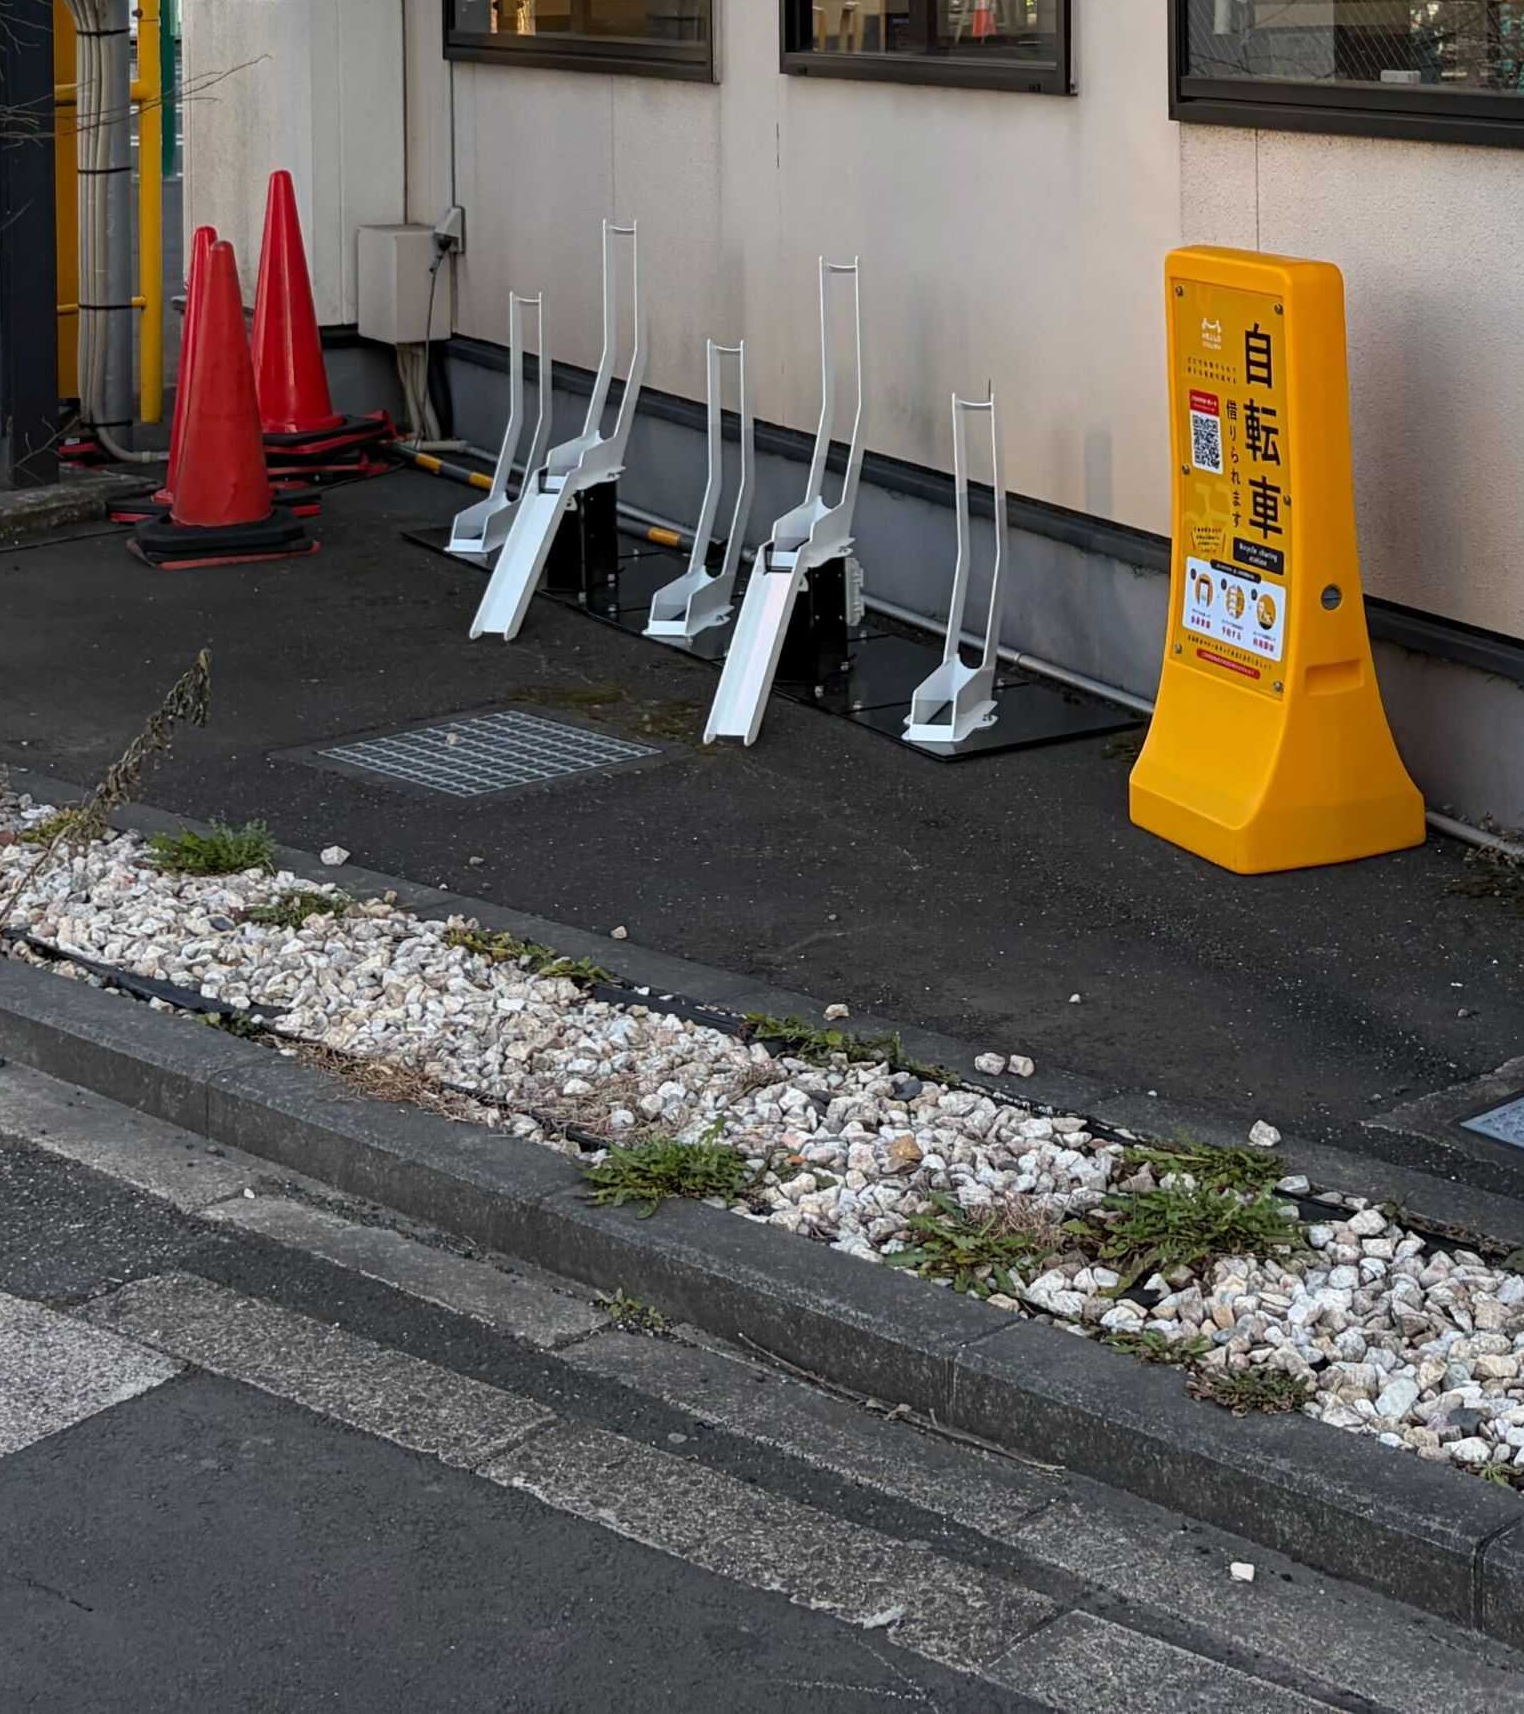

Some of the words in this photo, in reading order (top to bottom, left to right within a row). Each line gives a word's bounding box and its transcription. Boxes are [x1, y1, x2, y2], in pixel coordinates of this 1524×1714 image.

[1226, 399, 1242, 528] 借りられます
[1243, 322, 1283, 539] 自転車
